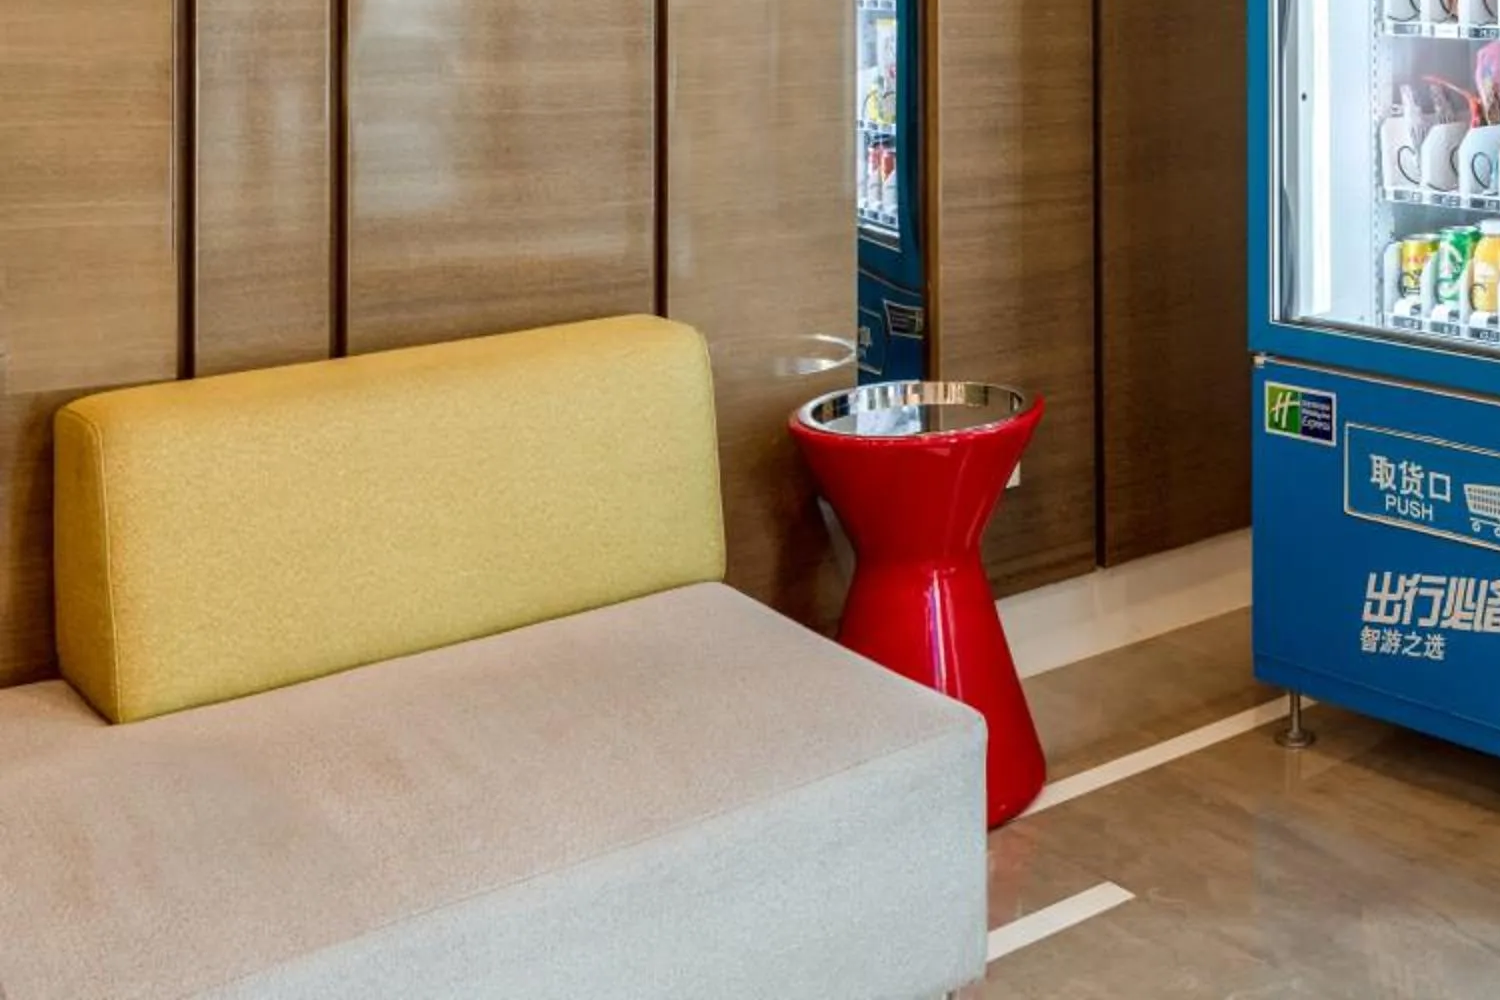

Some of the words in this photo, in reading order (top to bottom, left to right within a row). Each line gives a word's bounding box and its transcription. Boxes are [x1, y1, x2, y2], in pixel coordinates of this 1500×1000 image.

[1369, 453, 1451, 503] 取货口
[1385, 494, 1434, 522] PUSH
[1360, 625, 1446, 661] 智游之选
